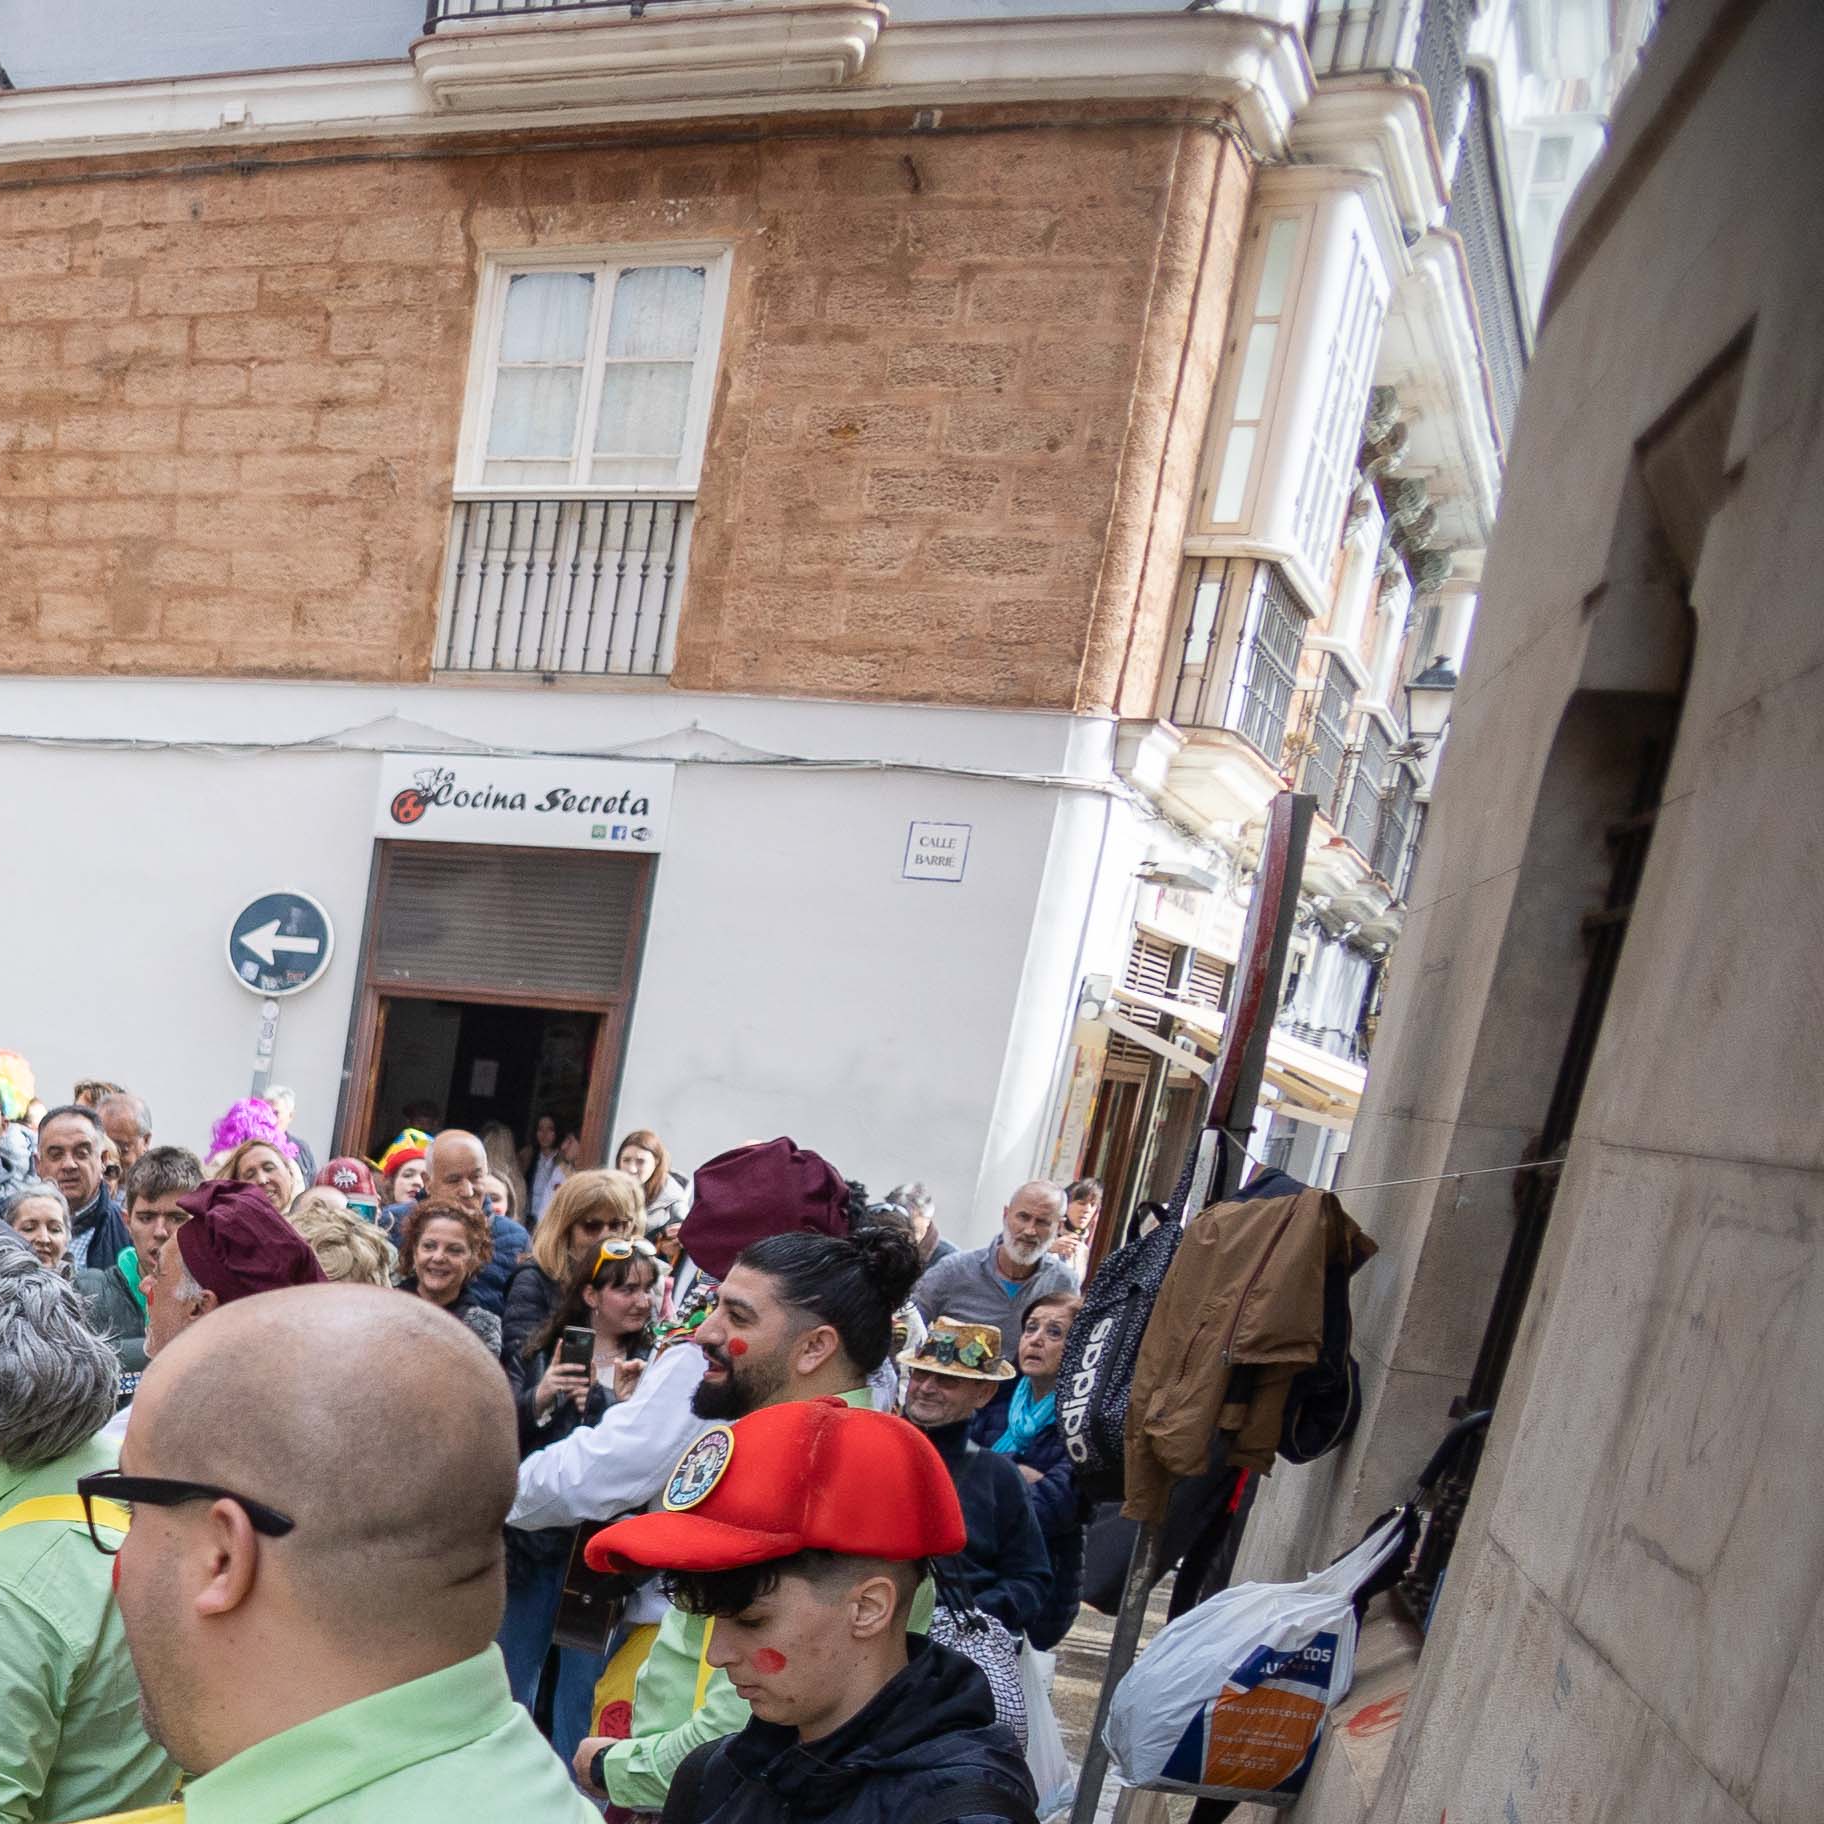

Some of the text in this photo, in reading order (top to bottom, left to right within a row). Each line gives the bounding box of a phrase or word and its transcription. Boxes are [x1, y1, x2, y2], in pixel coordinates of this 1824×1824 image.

[434, 782, 650, 817] Cocina Secreta
[919, 836, 958, 849] CALLE
[1061, 1317, 1113, 1464] adidas
